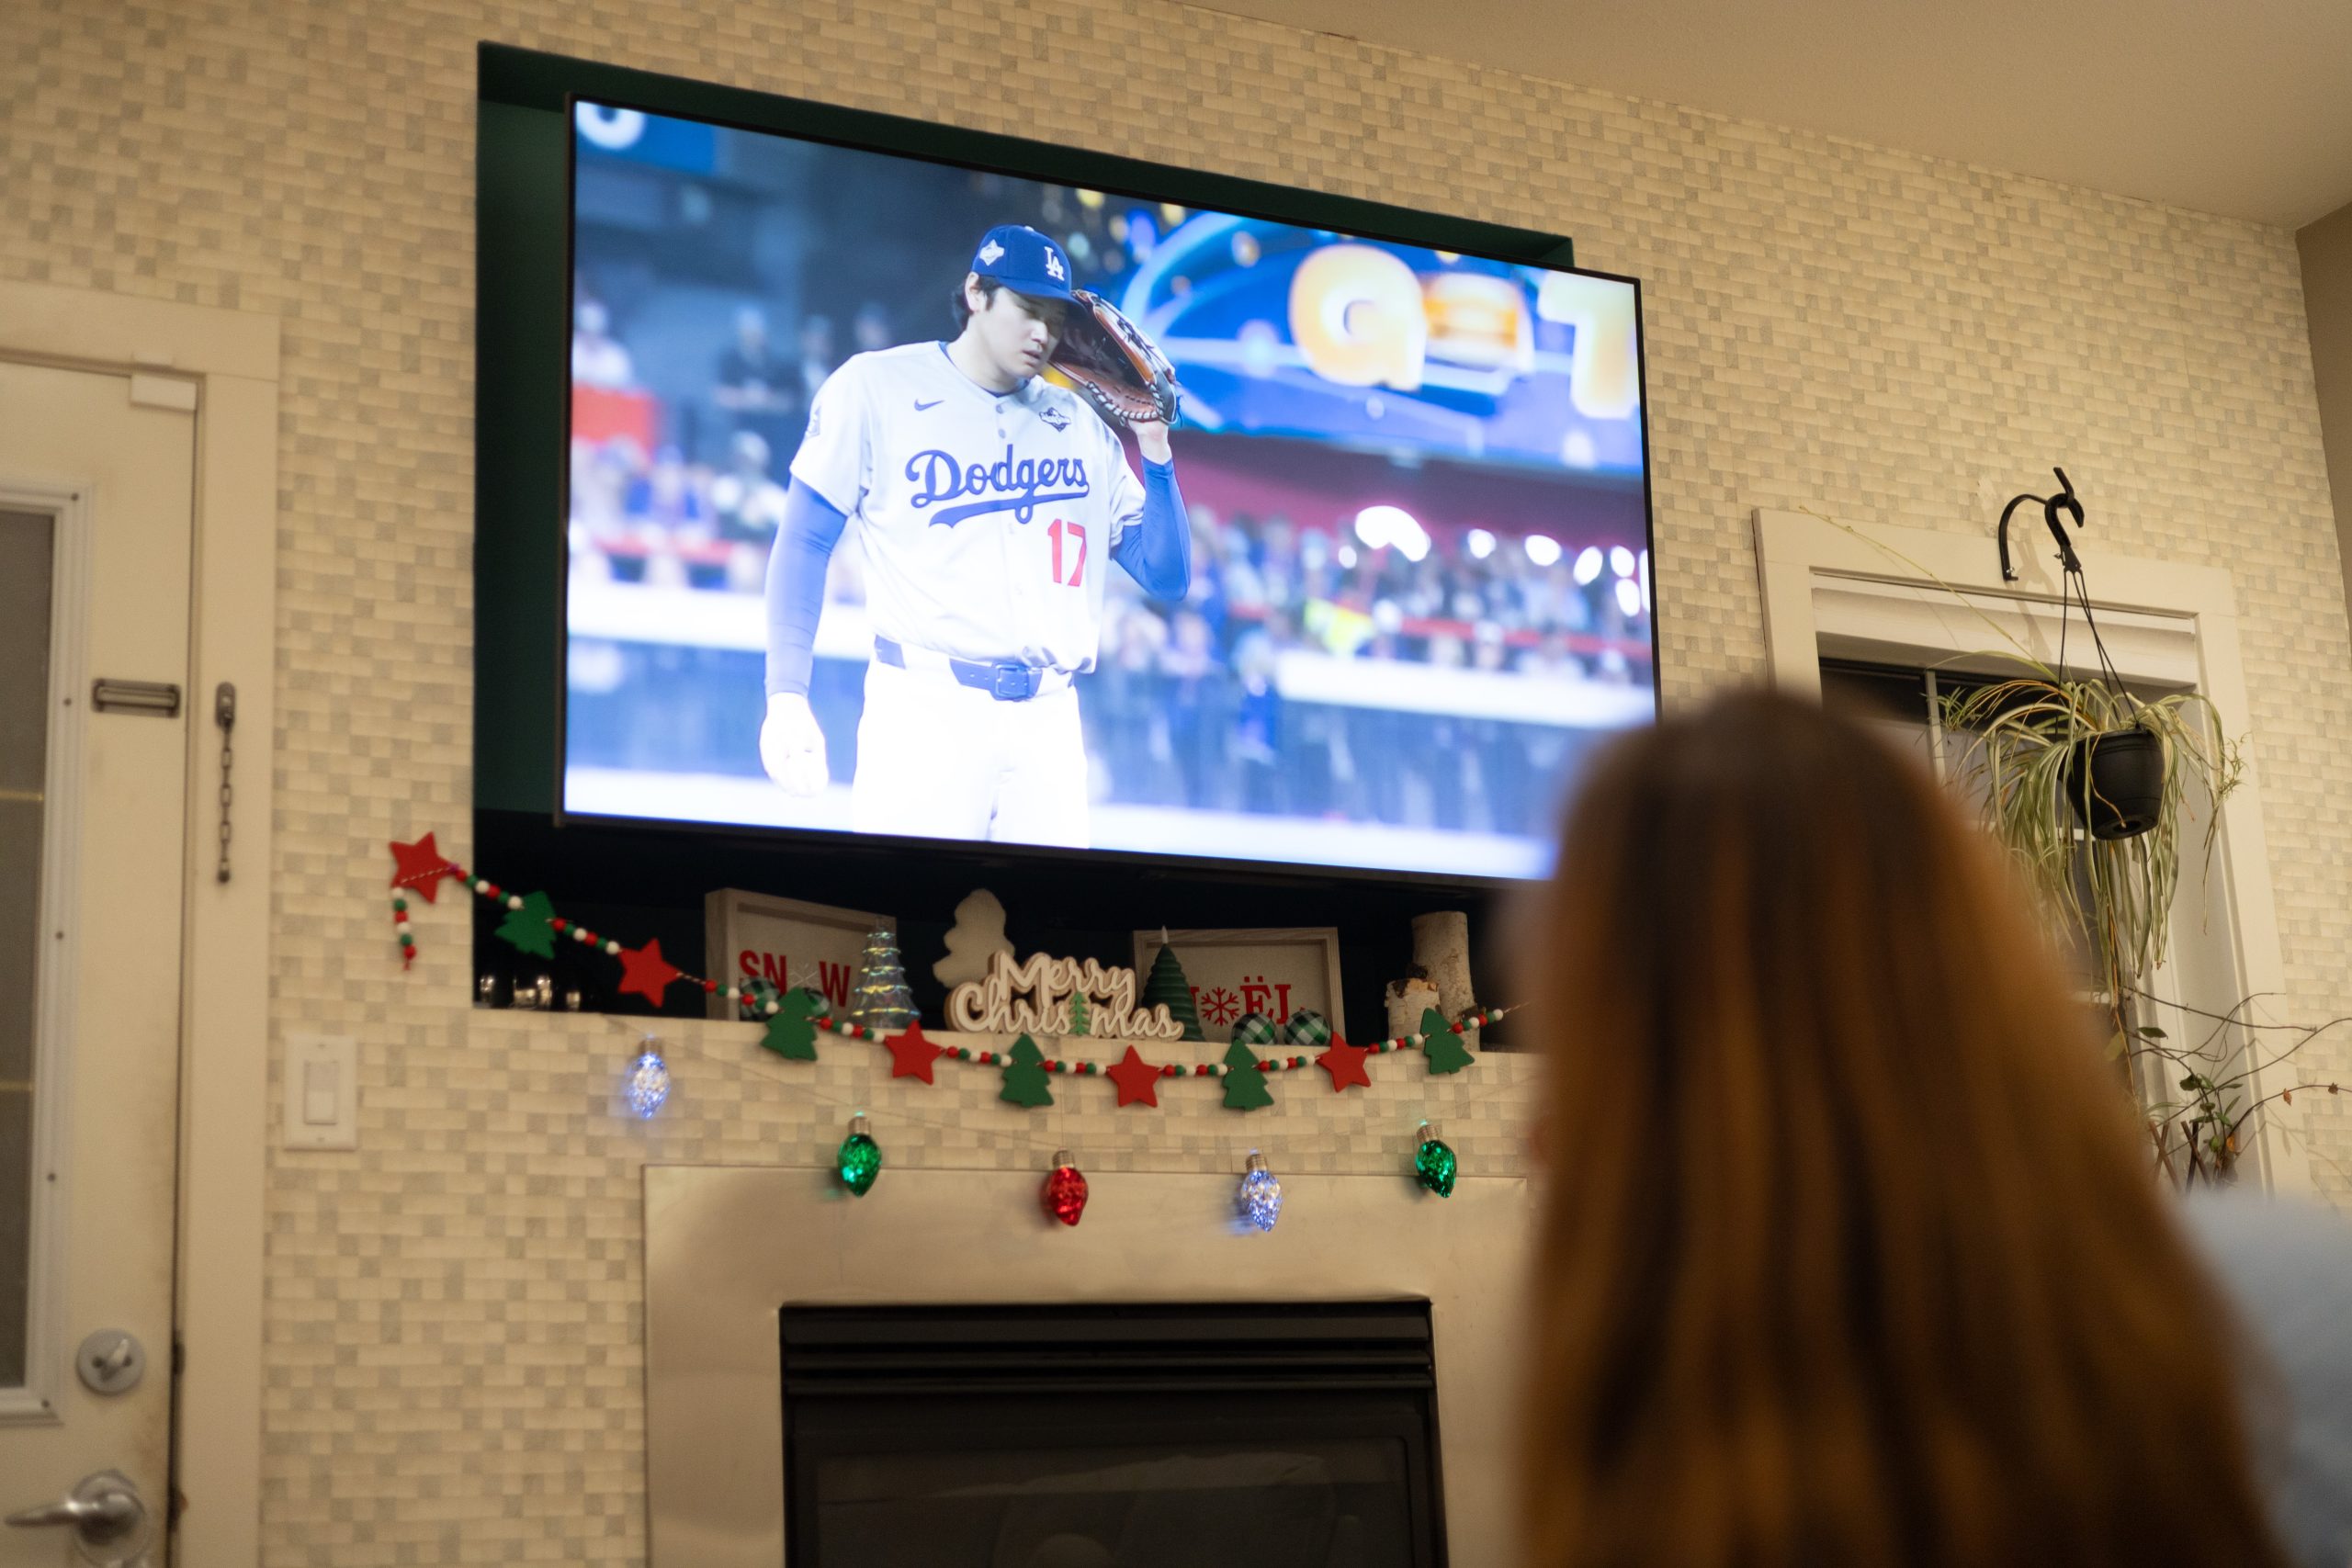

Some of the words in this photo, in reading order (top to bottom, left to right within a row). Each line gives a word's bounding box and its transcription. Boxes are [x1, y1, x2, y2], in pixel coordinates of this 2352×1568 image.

[1044, 245, 1065, 282] LA
[905, 444, 1090, 526] Dodgers
[1047, 518, 1088, 587] 17
[739, 949, 852, 1008] SNW
[955, 976, 1183, 1037] Chrismas
[998, 951, 1135, 1013] Merry
